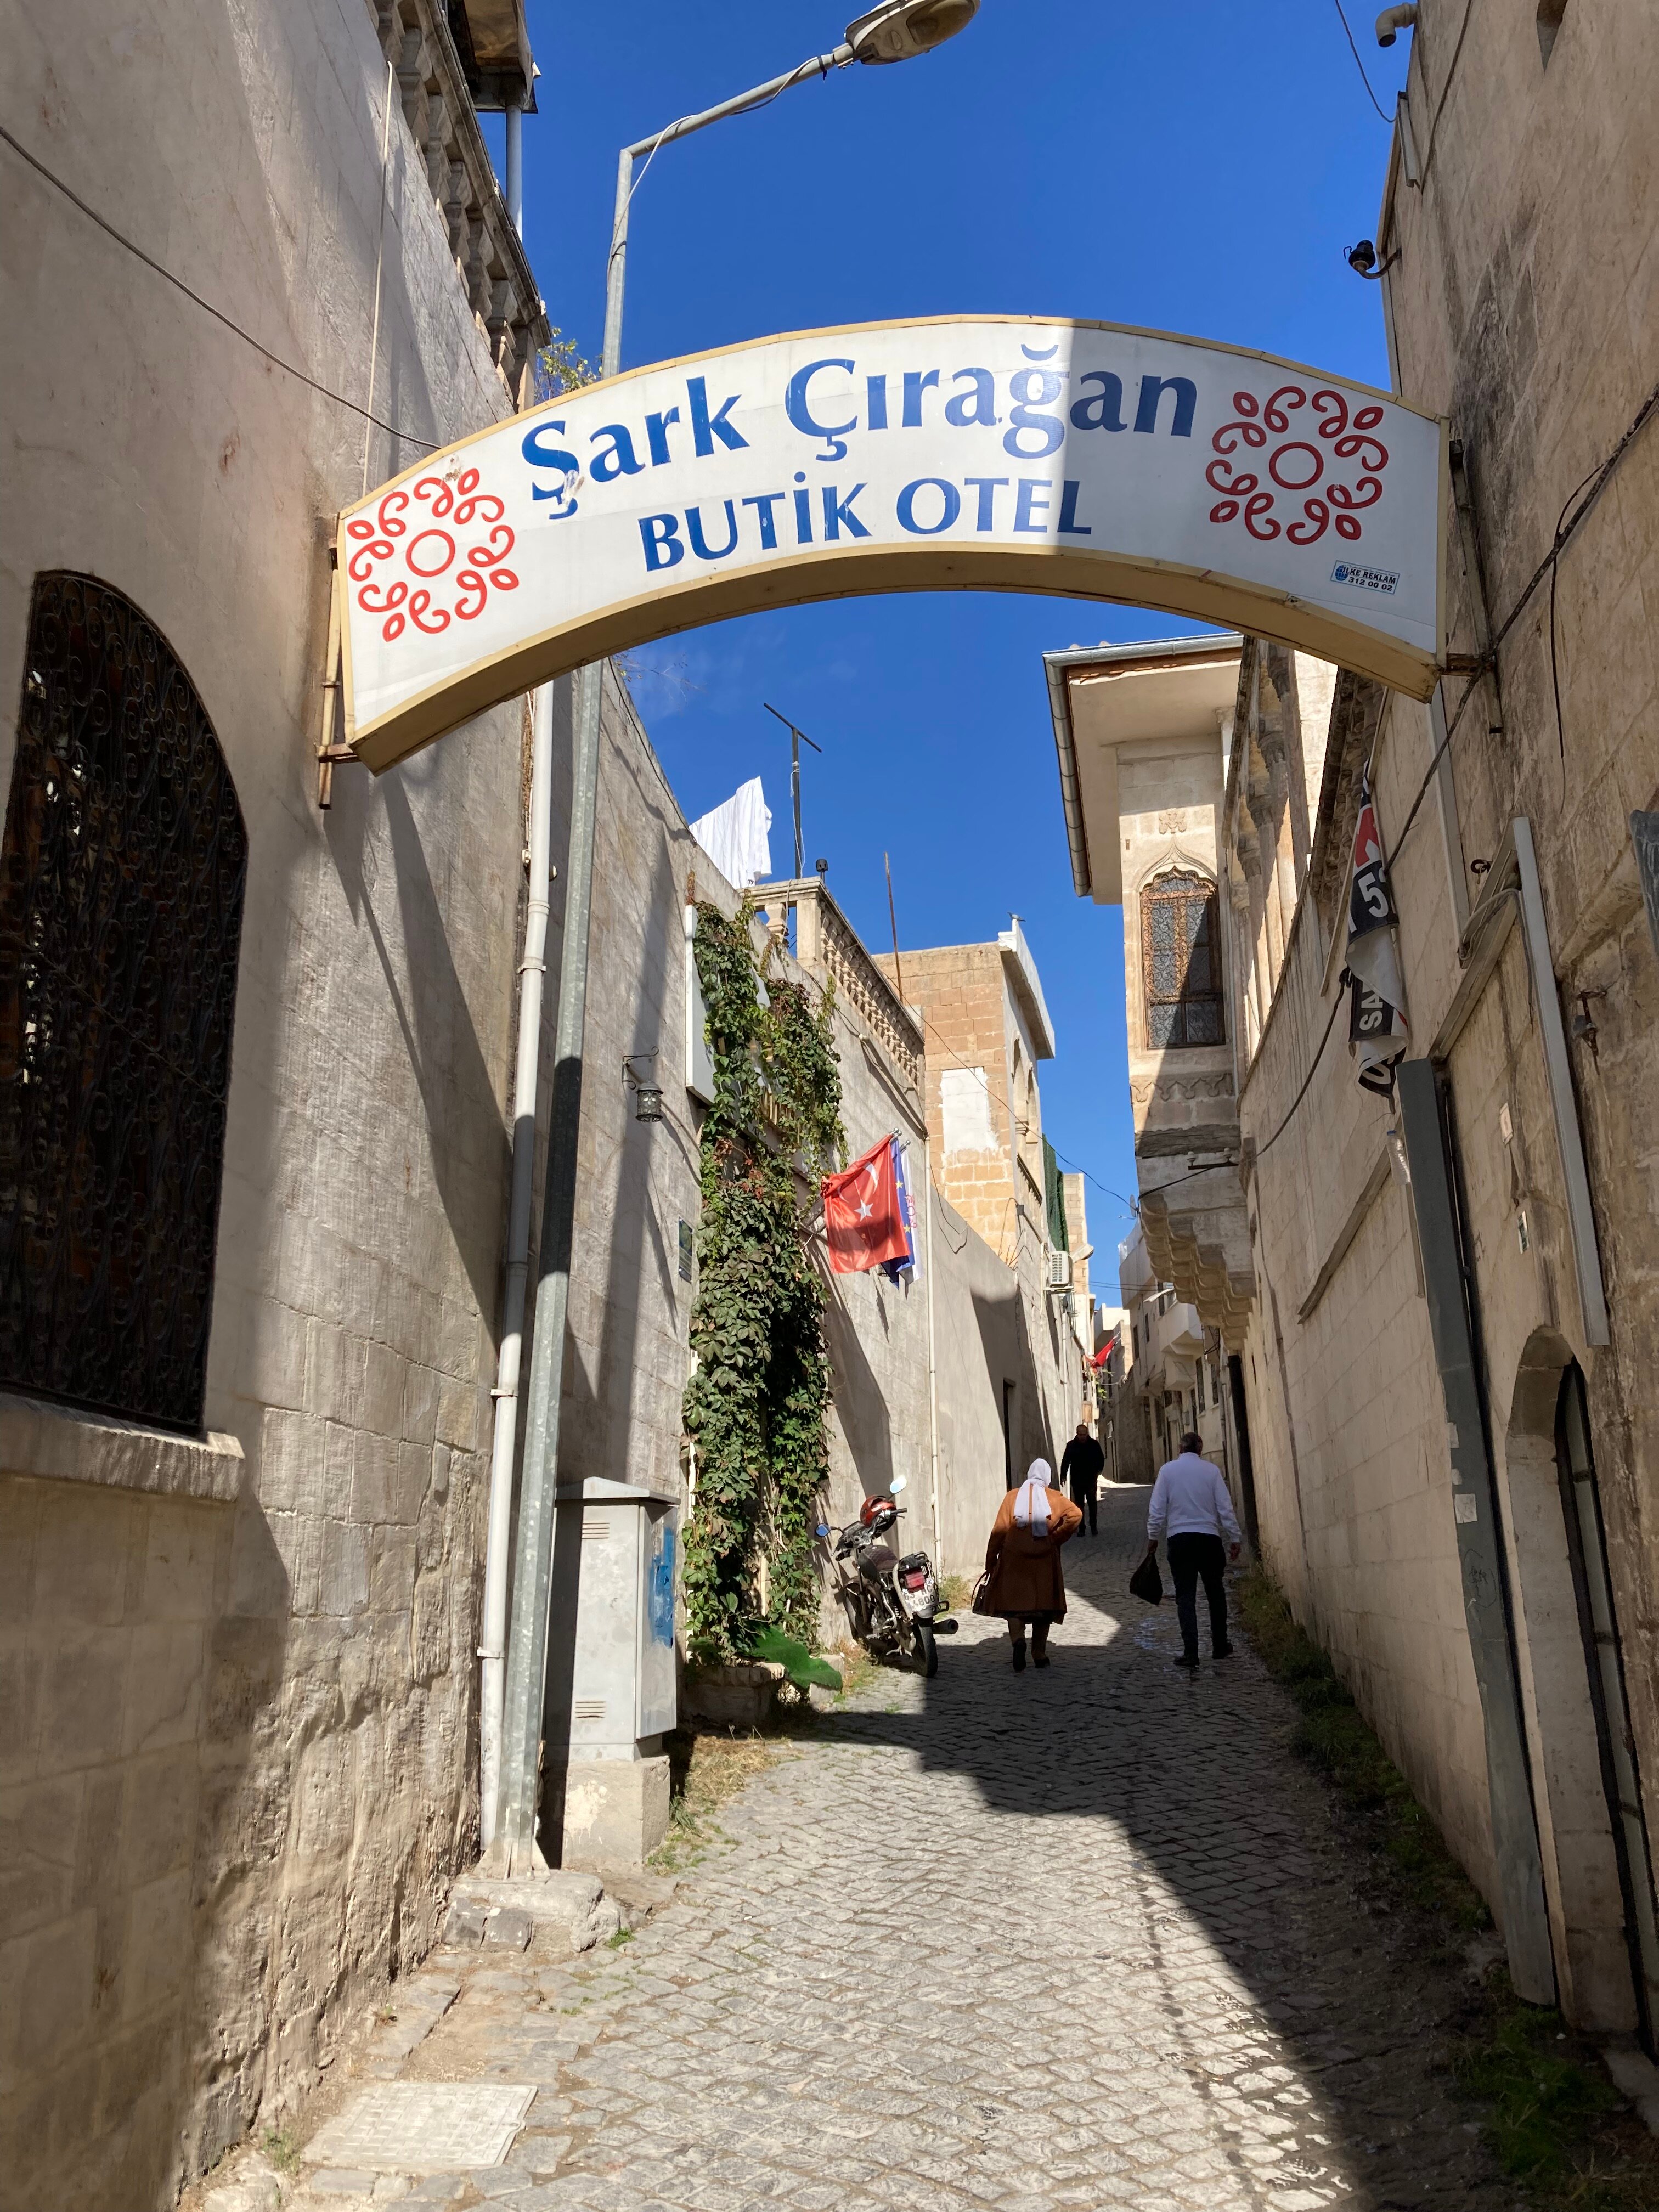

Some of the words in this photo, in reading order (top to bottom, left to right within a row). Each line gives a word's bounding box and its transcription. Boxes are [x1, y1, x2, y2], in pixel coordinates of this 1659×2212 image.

[522, 376, 749, 520] Şark
[785, 343, 1198, 461] Çırağan
[639, 471, 871, 572] BUTİK
[896, 478, 1092, 535] OTEL
[1348, 577, 1365, 585] 312
[1363, 571, 1397, 584] REKLAM
